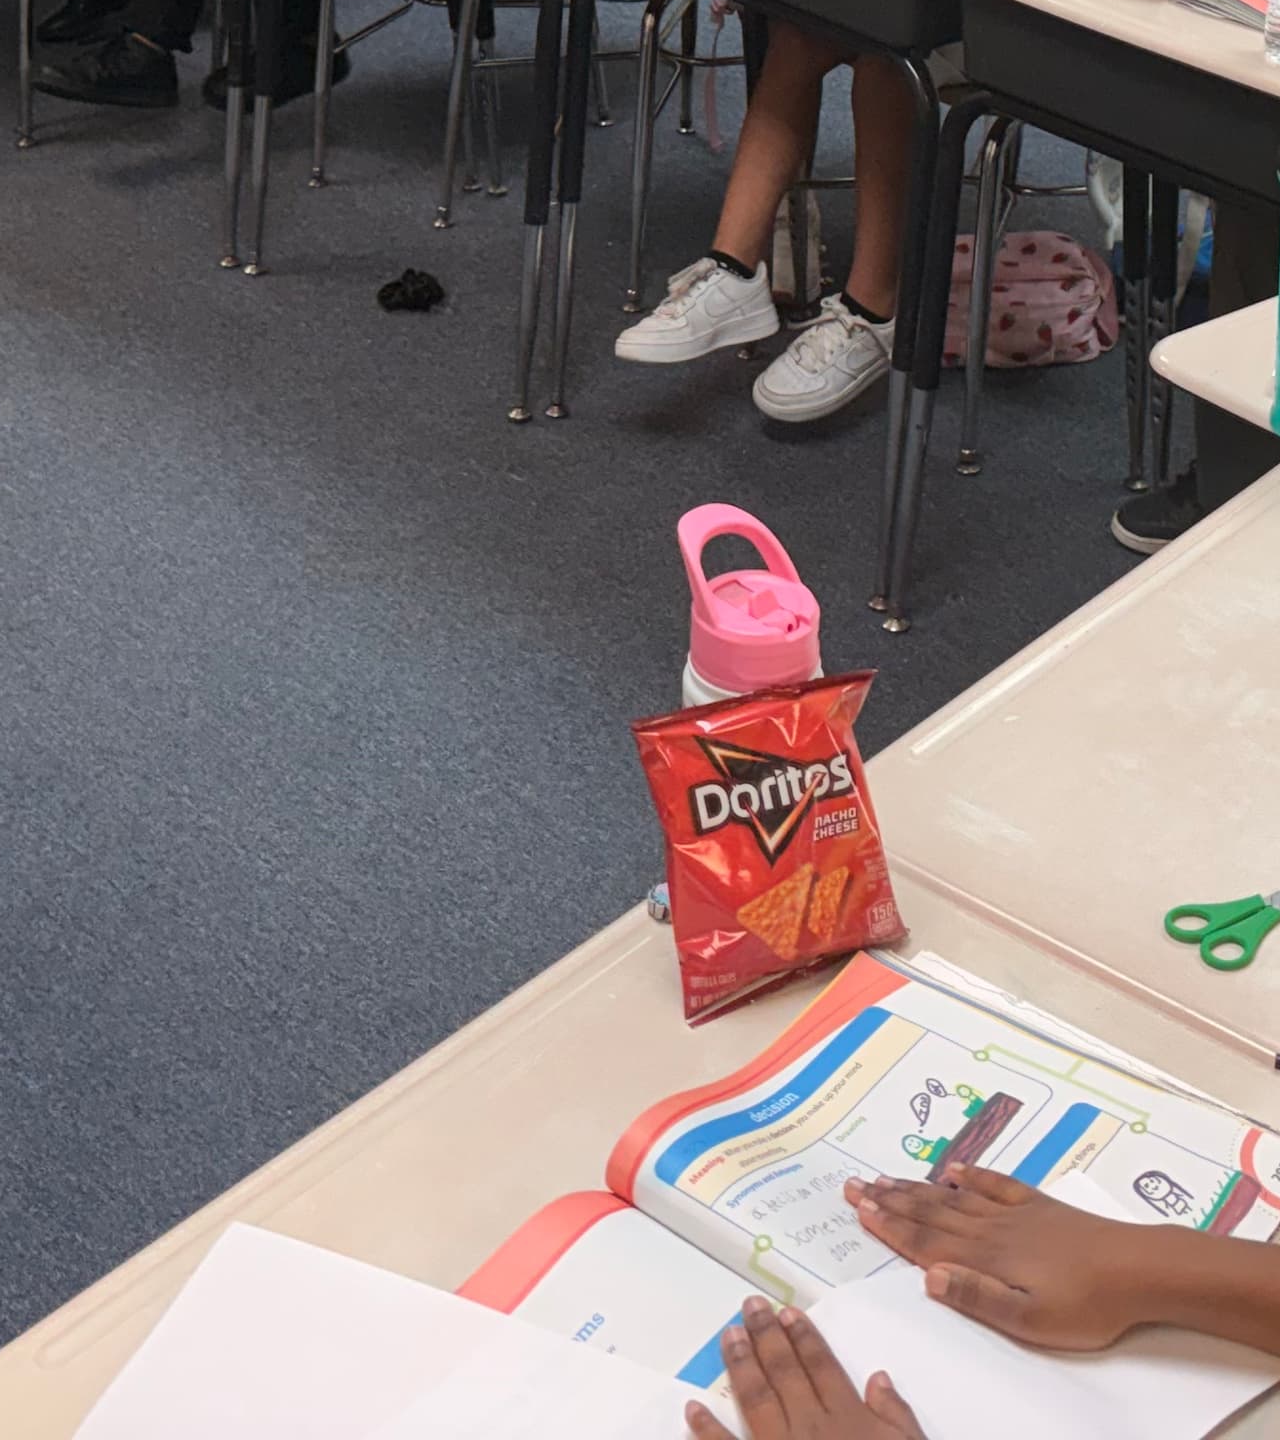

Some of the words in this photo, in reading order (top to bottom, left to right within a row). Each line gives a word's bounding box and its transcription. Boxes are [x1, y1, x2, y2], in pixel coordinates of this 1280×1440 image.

[695, 753, 854, 831] Doritos
[812, 818, 859, 842] CHEESE
[814, 807, 857, 827] NACHO
[872, 904, 893, 919] 150
[749, 1091, 800, 1123] decision
[835, 1115, 867, 1143] Drawing
